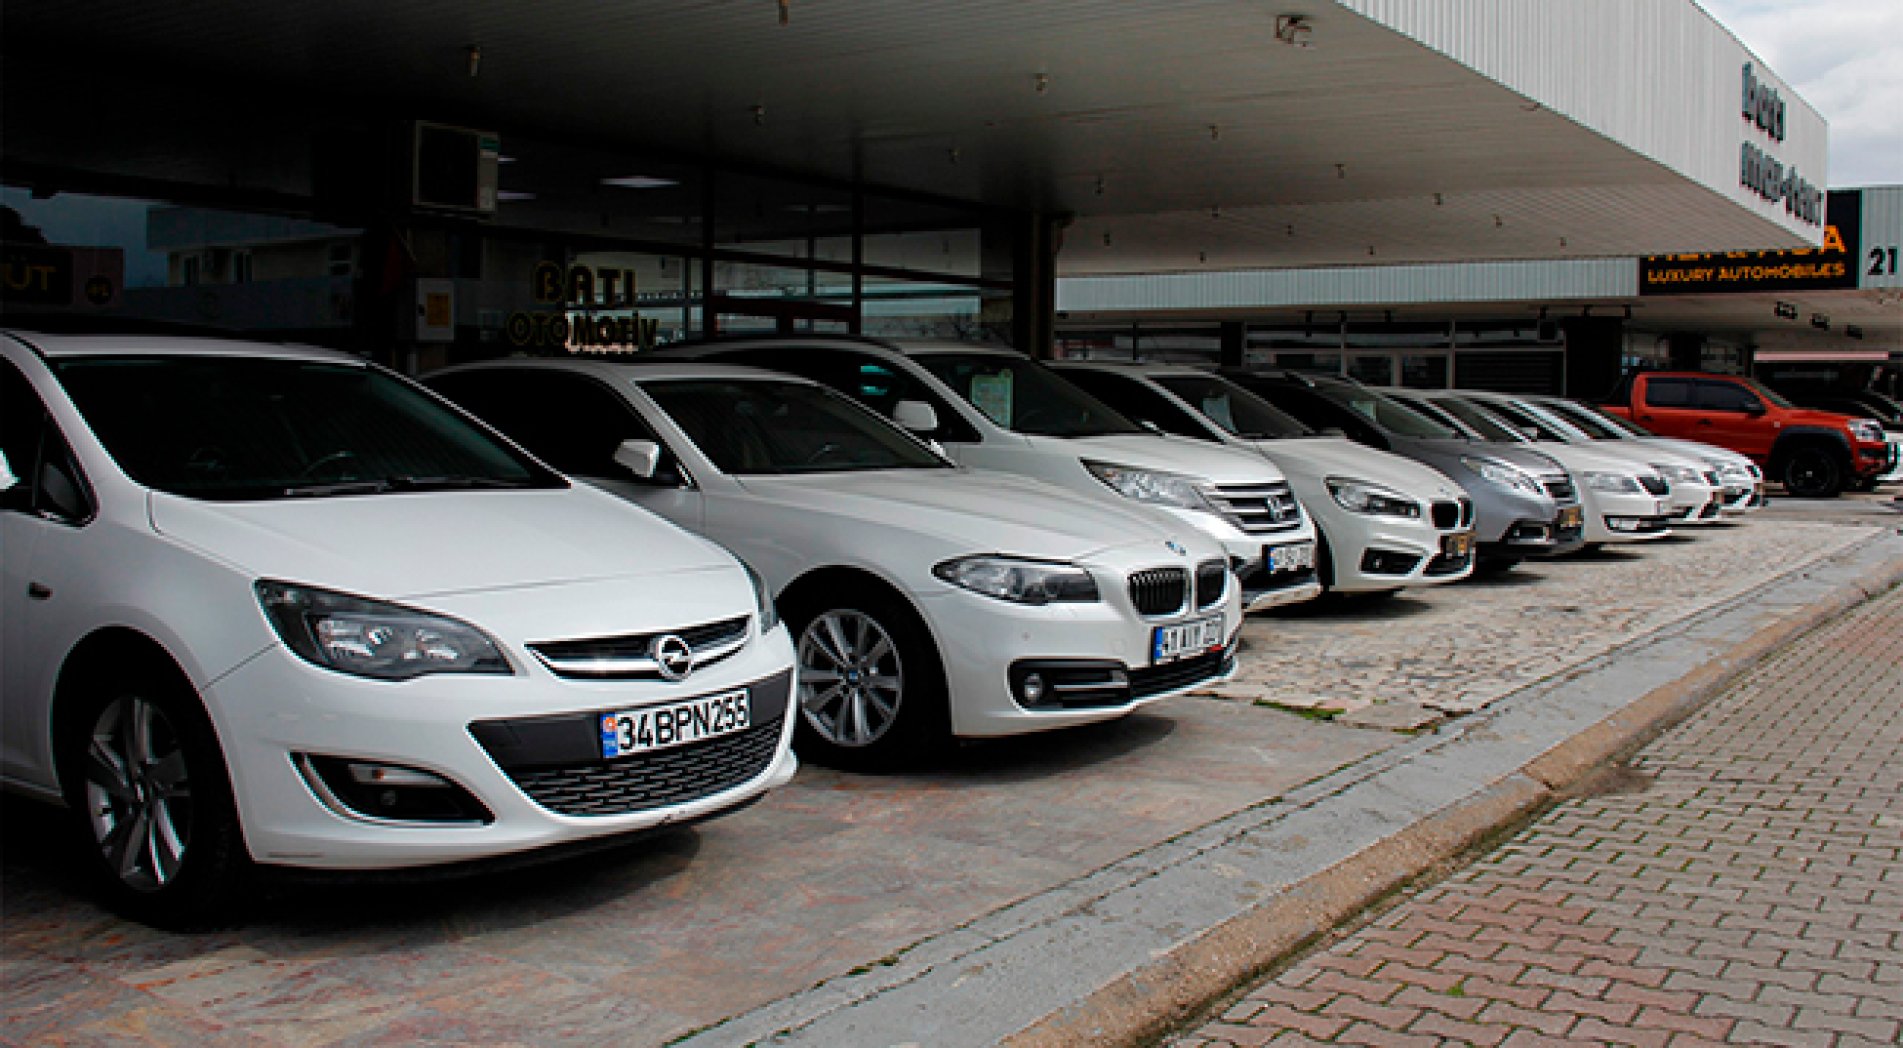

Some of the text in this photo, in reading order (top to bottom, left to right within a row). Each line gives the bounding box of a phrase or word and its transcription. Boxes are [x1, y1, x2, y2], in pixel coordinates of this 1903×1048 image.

[1648, 262, 1846, 284] LUXURY AUTOMOBILES
[1868, 247, 1898, 276] 21
[533, 261, 637, 308] BATI
